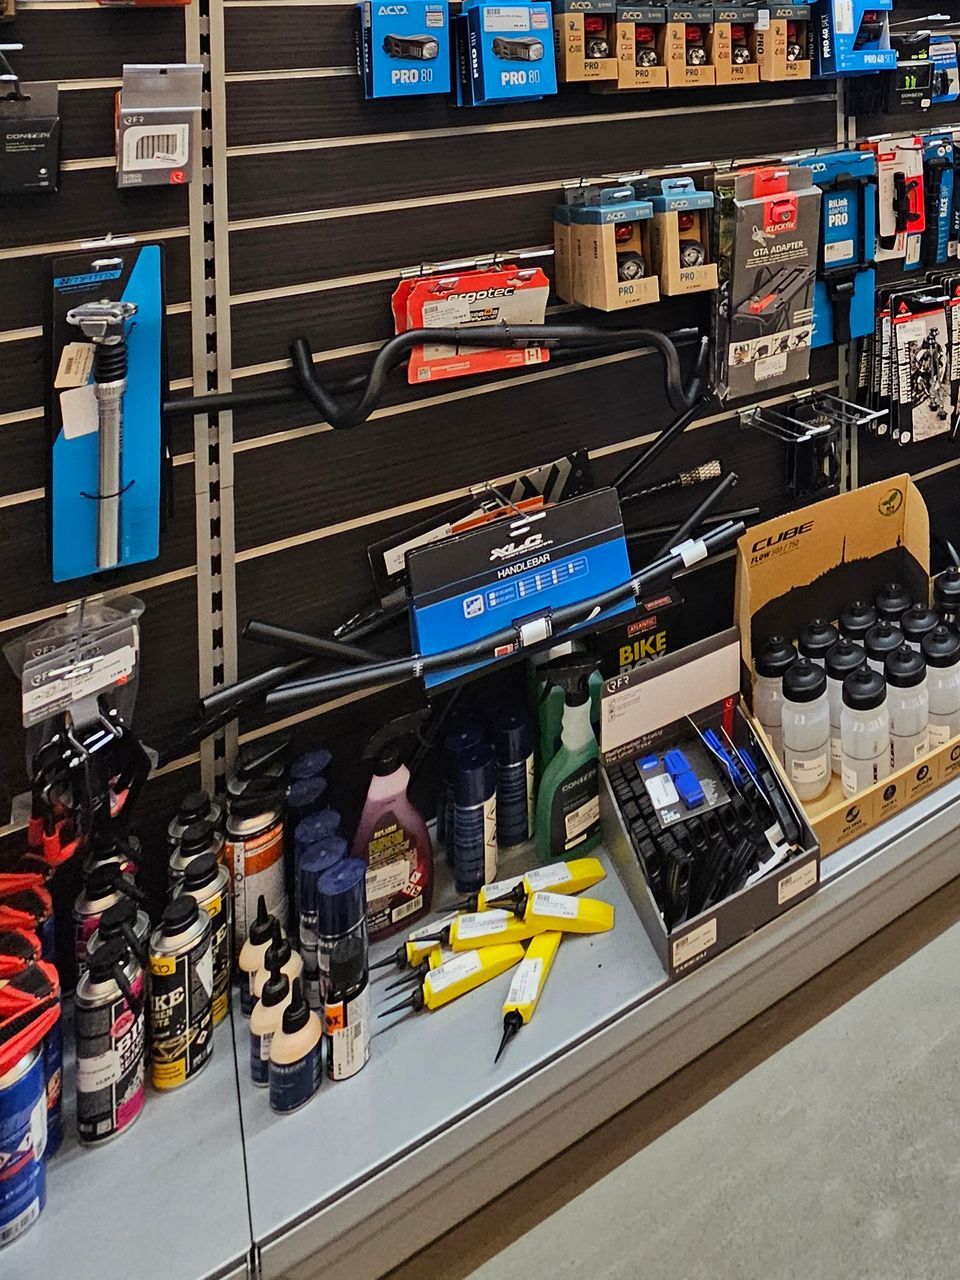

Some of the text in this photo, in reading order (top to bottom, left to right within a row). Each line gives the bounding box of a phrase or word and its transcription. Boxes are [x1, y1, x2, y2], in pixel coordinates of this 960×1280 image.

[864, 54, 877, 64] PRO
[391, 68, 433, 84] PRO 80
[501, 70, 541, 86] PRO 80
[812, 162, 826, 173] CID
[828, 213, 849, 228] PRO
[753, 240, 804, 257] GTA ADAPTER
[680, 271, 695, 282] PRO
[447, 286, 515, 304] ergotec
[618, 285, 634, 296] PRO
[752, 520, 815, 554] CUBE
[497, 553, 551, 579] HANDLEBAR
[750, 551, 771, 565] FLOW
[619, 630, 667, 666] BIKE
[607, 676, 629, 693] RFR
